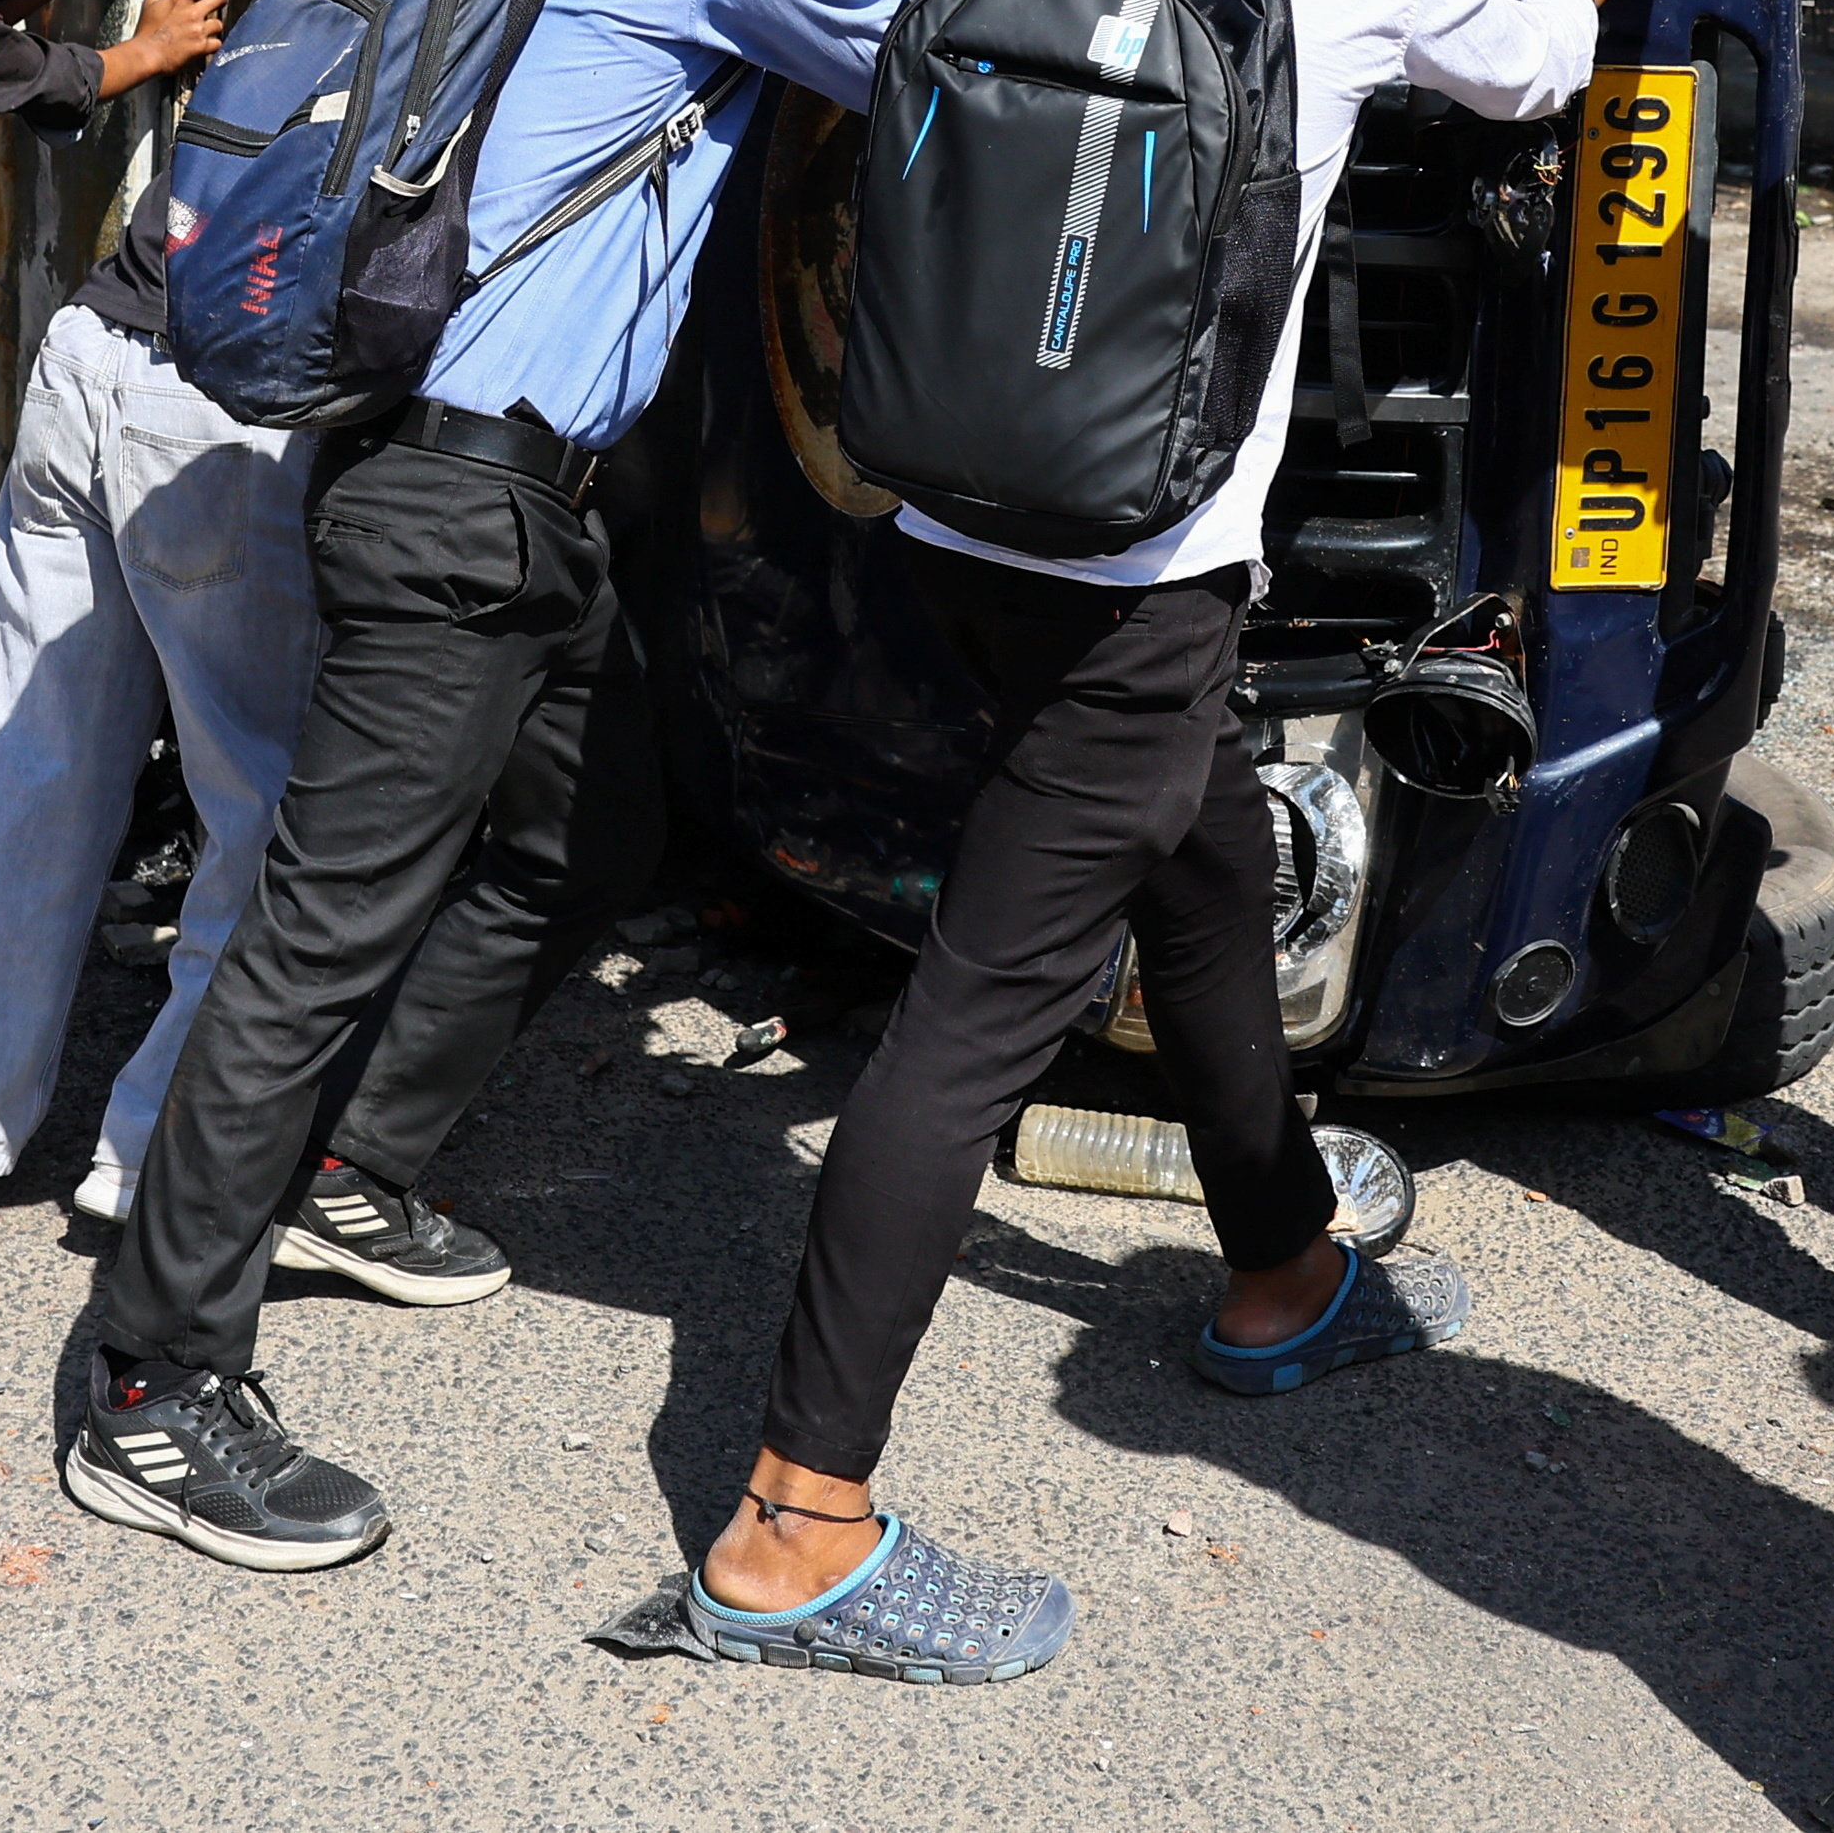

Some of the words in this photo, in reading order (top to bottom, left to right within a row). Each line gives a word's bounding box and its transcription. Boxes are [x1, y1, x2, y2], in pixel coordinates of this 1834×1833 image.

[1114, 26, 1145, 65] hp
[240, 223, 284, 315] NIKE
[1051, 268, 1077, 350] CANTALOUPE
[1069, 239, 1082, 265] PRO
[1600, 538, 1618, 575] IND
